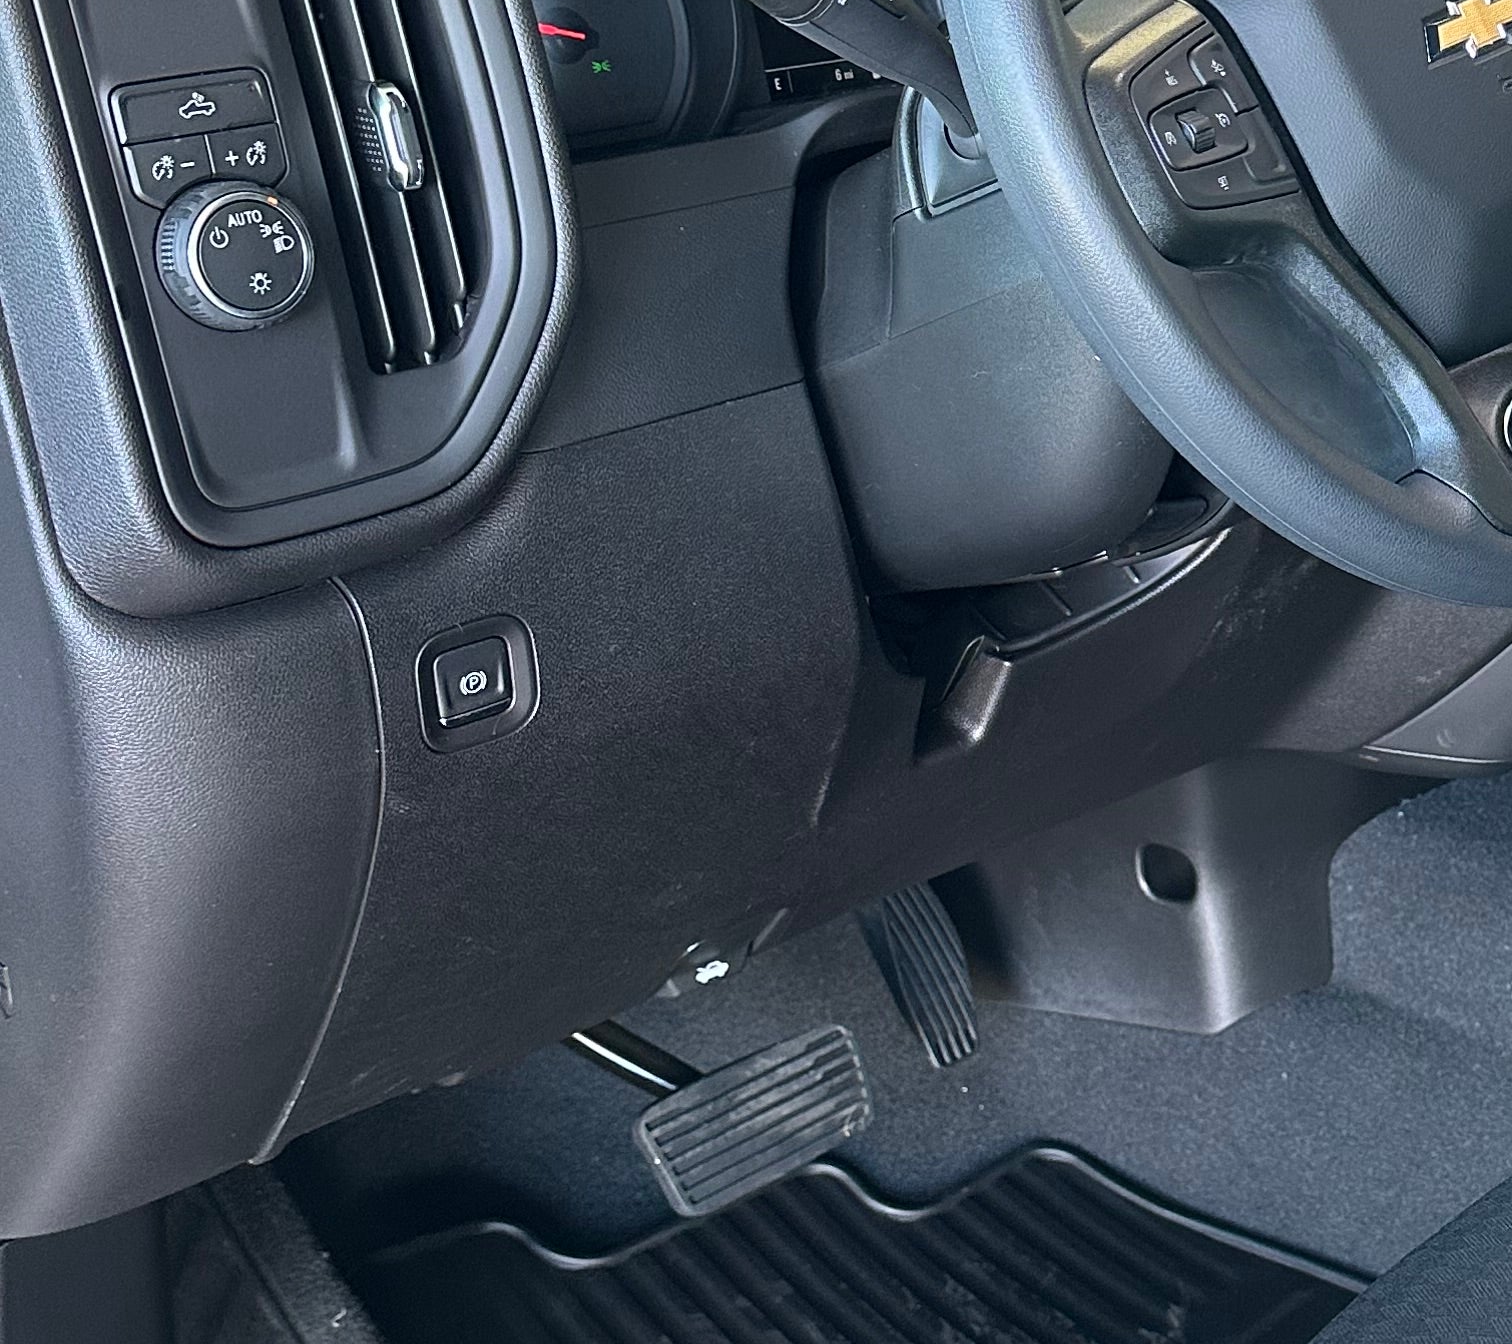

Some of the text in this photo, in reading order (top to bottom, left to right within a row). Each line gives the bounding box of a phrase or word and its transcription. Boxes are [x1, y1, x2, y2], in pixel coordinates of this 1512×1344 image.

[834, 68, 843, 82] 6
[773, 76, 783, 91] E
[227, 209, 263, 228] AUTO
